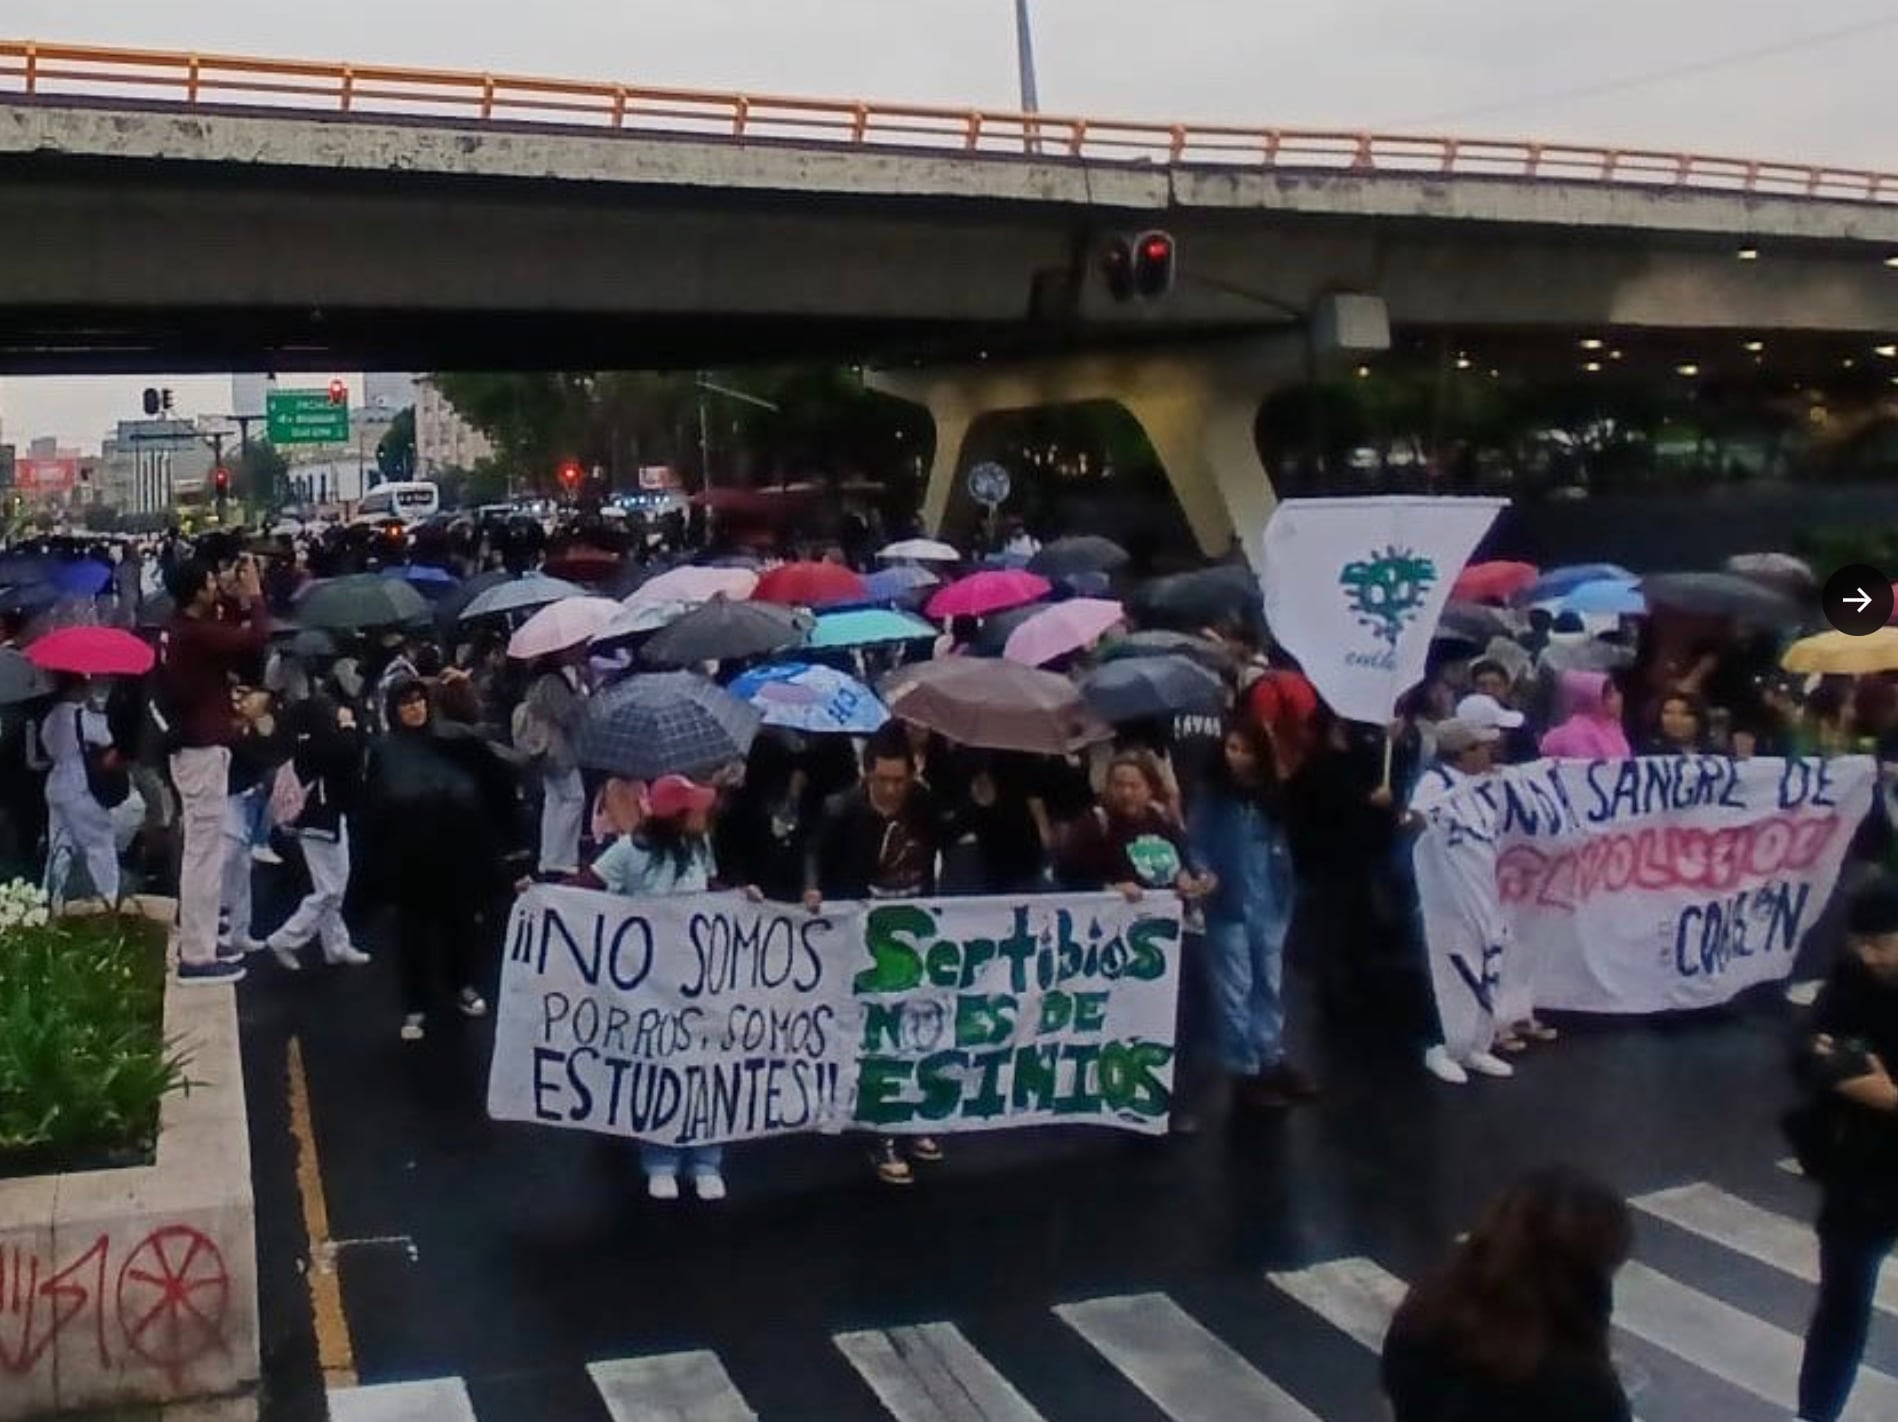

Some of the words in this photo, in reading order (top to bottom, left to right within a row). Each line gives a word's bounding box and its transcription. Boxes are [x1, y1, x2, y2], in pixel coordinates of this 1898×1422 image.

[1587, 756, 1747, 822] SANGRE
[1777, 756, 1837, 810] DE
[680, 913, 834, 998] SOMOS
[720, 1004, 835, 1058] SOMOS
[955, 993, 1018, 1047] ES
[1036, 990, 1111, 1035] DE
[533, 1046, 838, 1144] ESTUDIANTES!!
[852, 1038, 1175, 1125] ESIMIOS
